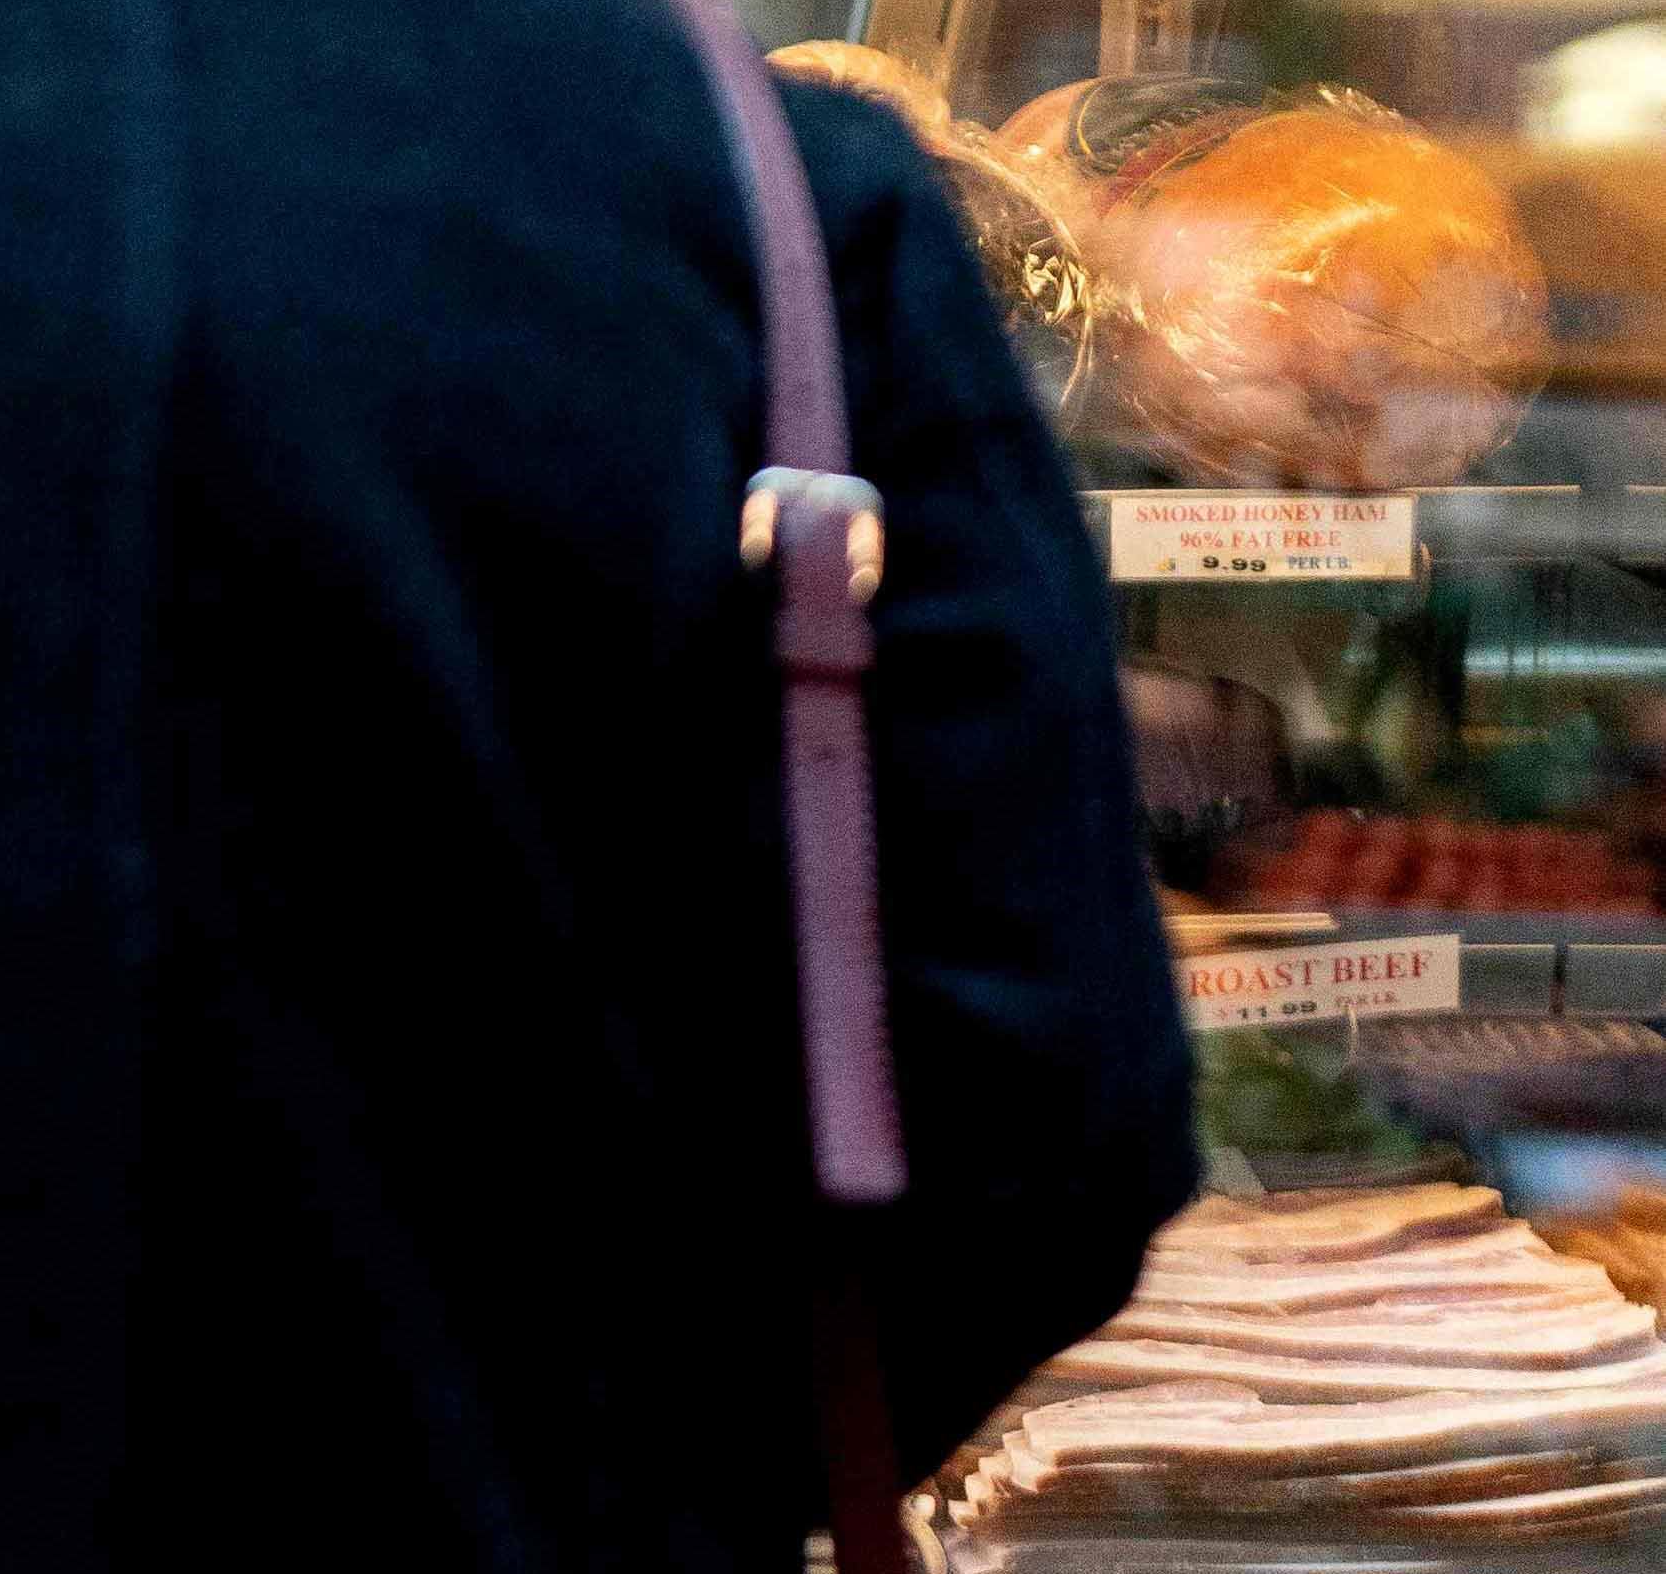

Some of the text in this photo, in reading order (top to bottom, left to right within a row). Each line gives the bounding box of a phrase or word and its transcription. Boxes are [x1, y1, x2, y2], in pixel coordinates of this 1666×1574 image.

[1135, 503, 1389, 524] SMOKED HONEY HAM
[1179, 529, 1342, 549] 96% FAT FREE
[1201, 555, 1267, 573] 9.99
[1188, 948, 1435, 998] ROAST BEEF
